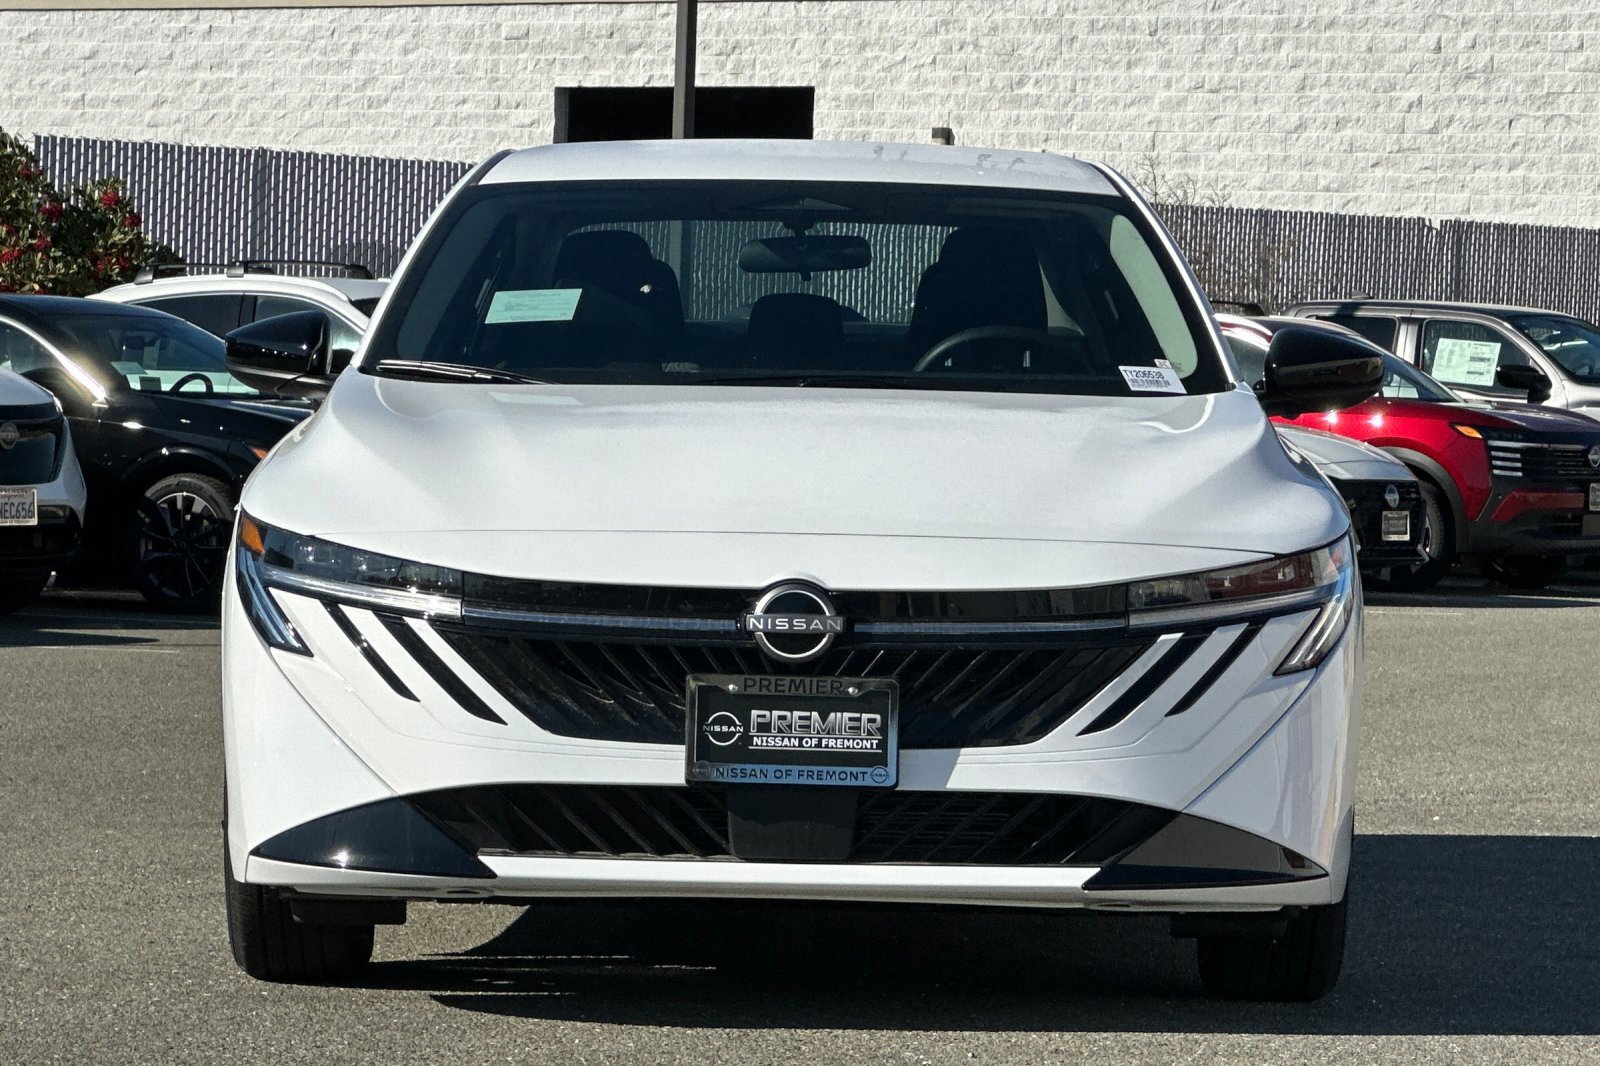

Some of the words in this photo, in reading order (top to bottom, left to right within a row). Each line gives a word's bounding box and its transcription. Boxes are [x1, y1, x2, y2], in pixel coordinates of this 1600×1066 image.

[750, 618, 841, 631] NISSAN
[743, 677, 844, 695] PREMIER
[702, 724, 744, 733] NISSAN
[750, 709, 882, 737] PREMIER
[752, 736, 799, 748] NISSAN
[802, 737, 819, 748] OF
[821, 737, 879, 750] FREMONT
[715, 767, 769, 780] NISSAN
[773, 768, 793, 780] OF
[797, 770, 868, 783] FREMONT
